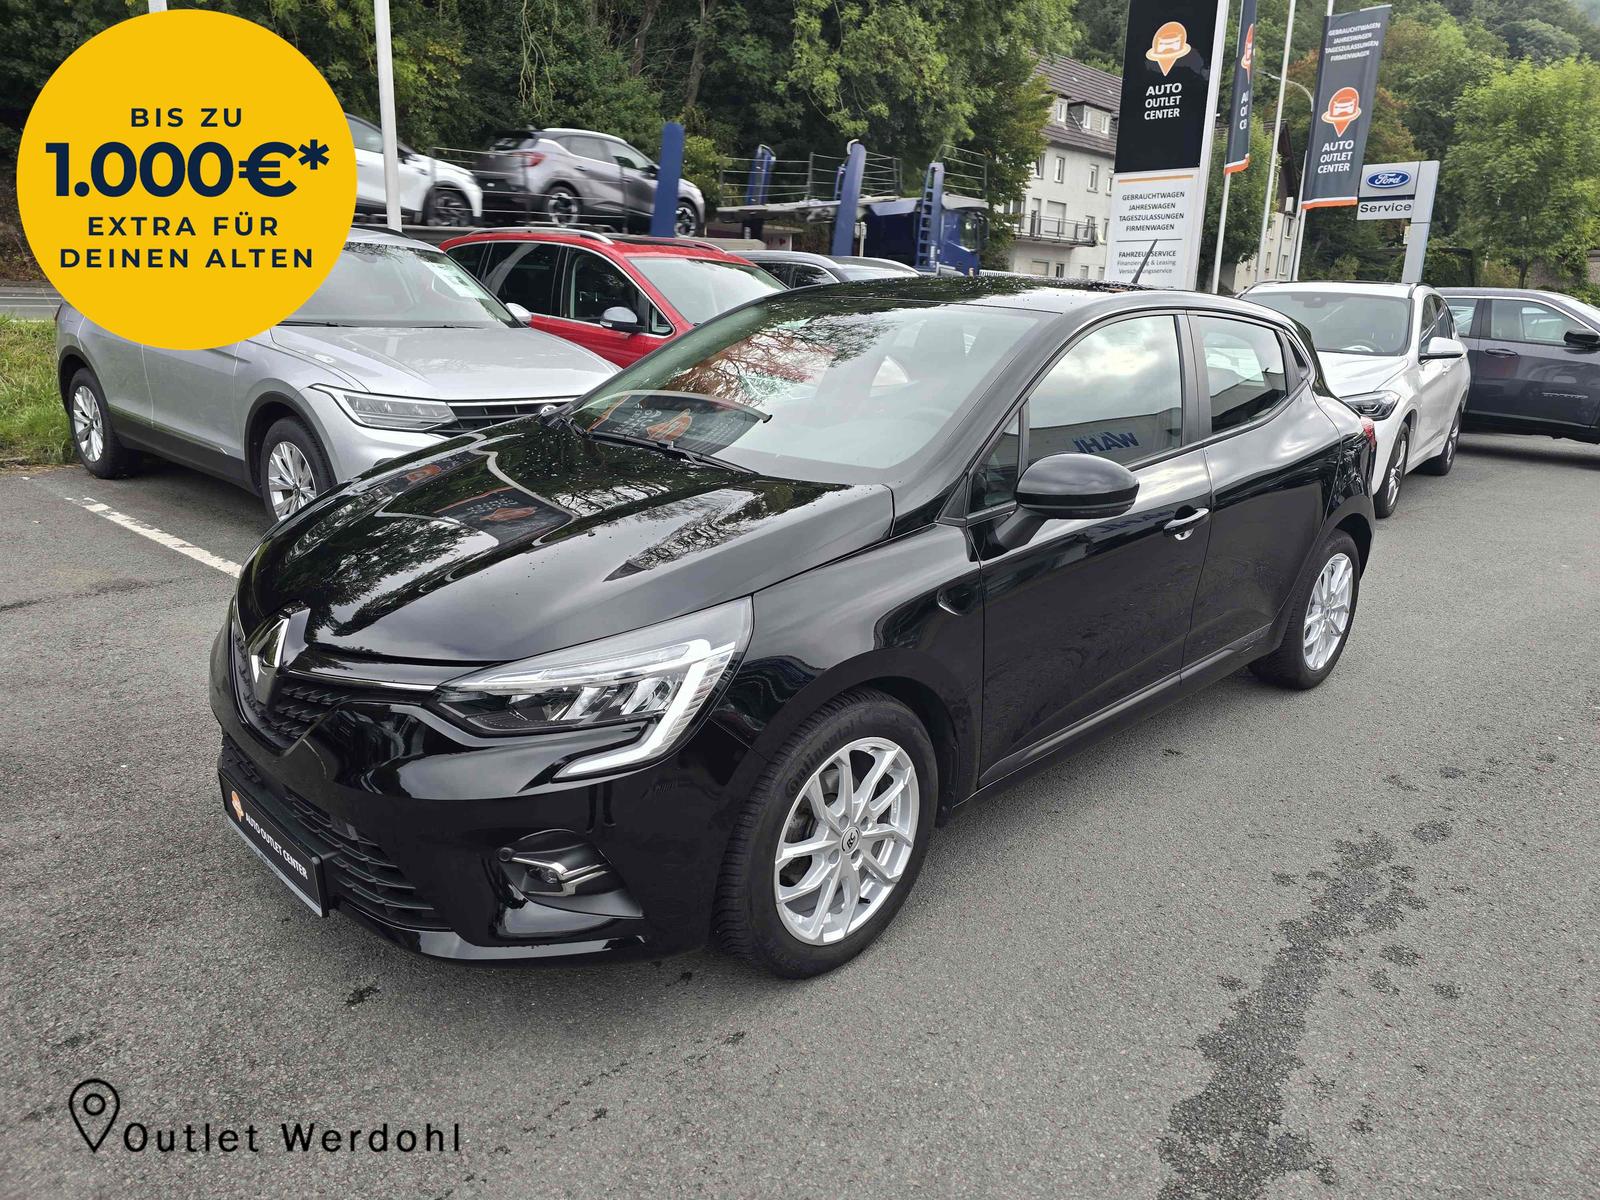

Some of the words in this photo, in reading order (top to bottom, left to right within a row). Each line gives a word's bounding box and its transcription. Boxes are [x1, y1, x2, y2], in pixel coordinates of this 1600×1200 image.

[1328, 22, 1381, 36] GEBRAUCHTWAGEN
[1145, 82, 1182, 96] AUTO
[1145, 95, 1182, 108] OUTLET
[1144, 107, 1180, 120] CENTER
[1321, 140, 1354, 152] AUTO
[1320, 151, 1353, 163] OUTLET
[1317, 162, 1350, 174] CENTER
[1369, 173, 1402, 185] Ford
[1121, 191, 1185, 201] GEBRAUCHTWAGEN
[1128, 202, 1176, 211] JAHRESWAGEN
[1359, 202, 1412, 213] Service
[1119, 212, 1184, 222] TAGESZULASSUNGEN
[1125, 223, 1175, 232] FIRMENWAGEN
[245, 812, 261, 834] AUTO
[260, 827, 283, 856] OUTLET
[282, 849, 309, 880] CENTER
